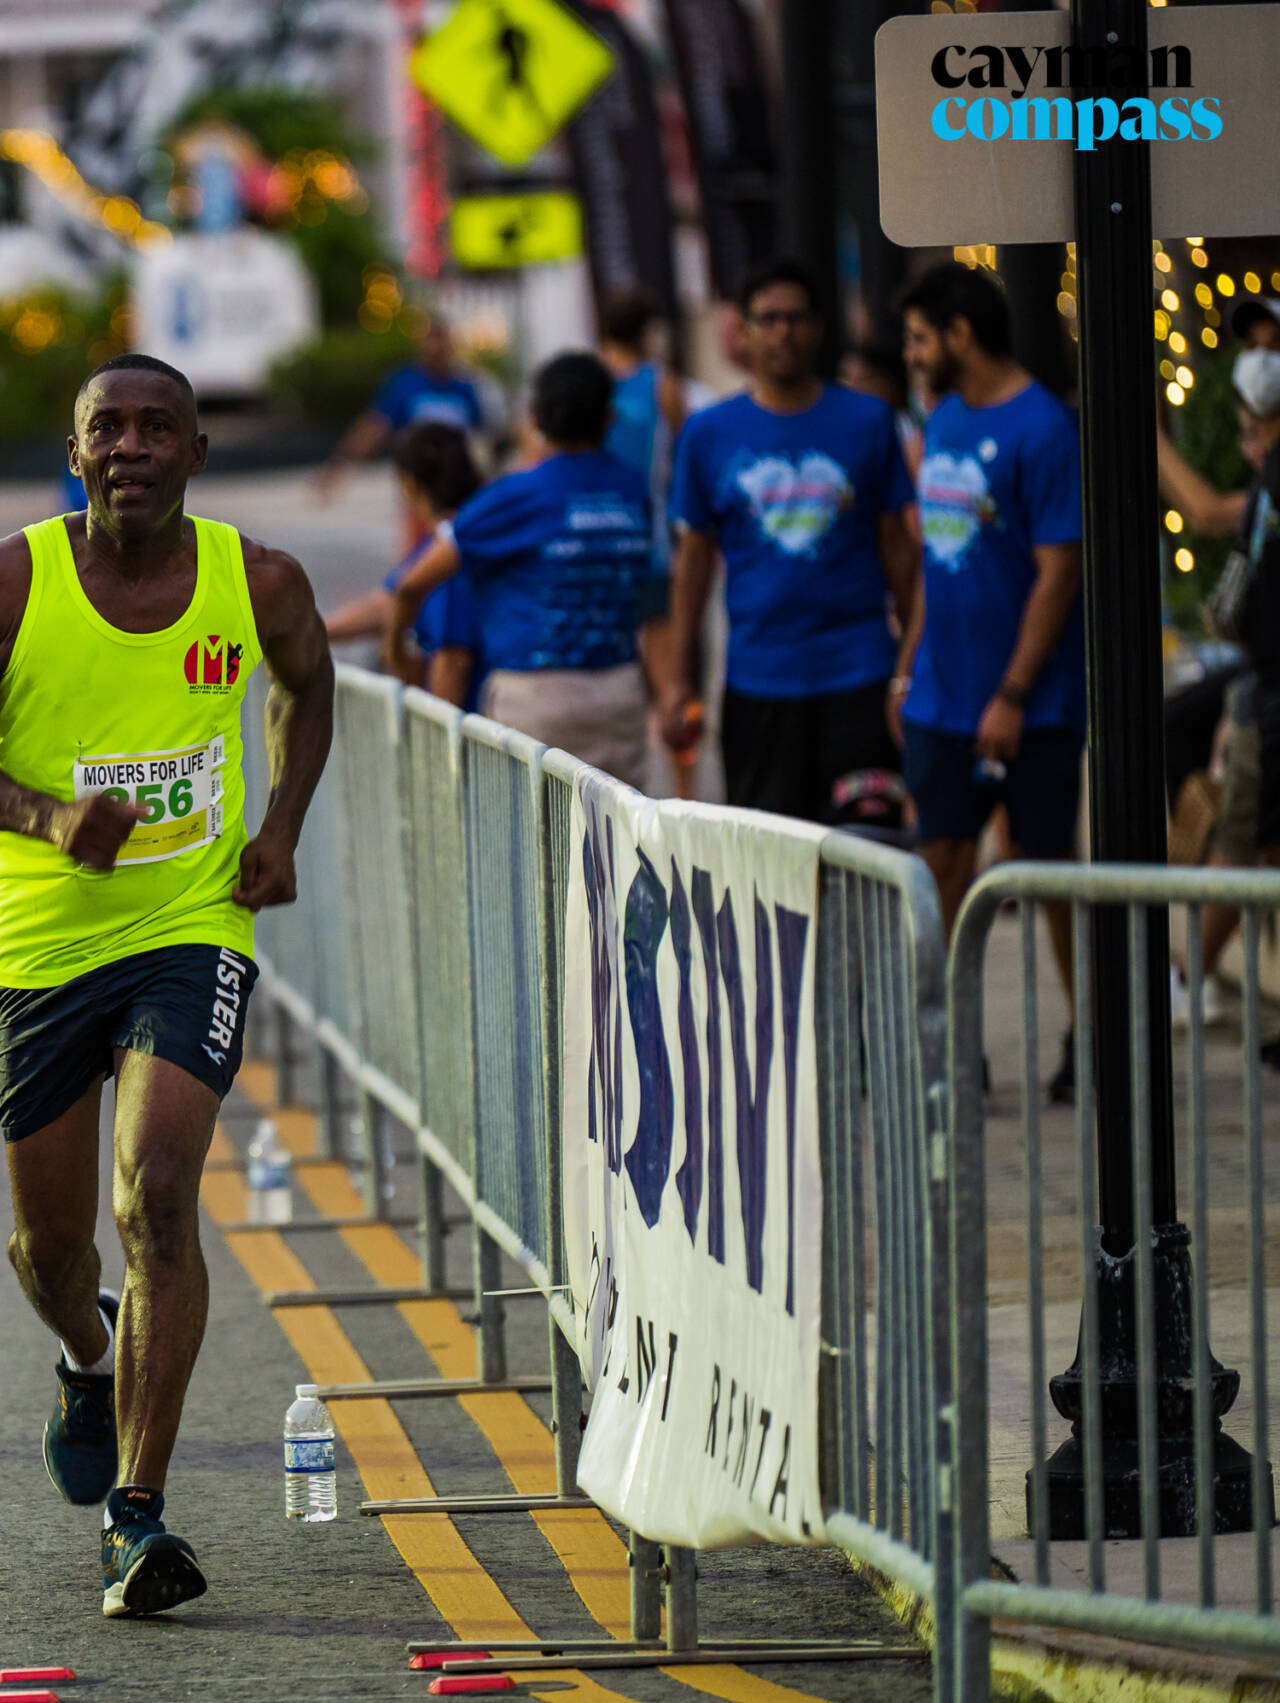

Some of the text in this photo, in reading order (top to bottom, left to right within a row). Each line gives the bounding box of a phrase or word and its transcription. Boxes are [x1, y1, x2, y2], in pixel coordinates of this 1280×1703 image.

[84, 752, 204, 786] MOVERS FOR LIFE
